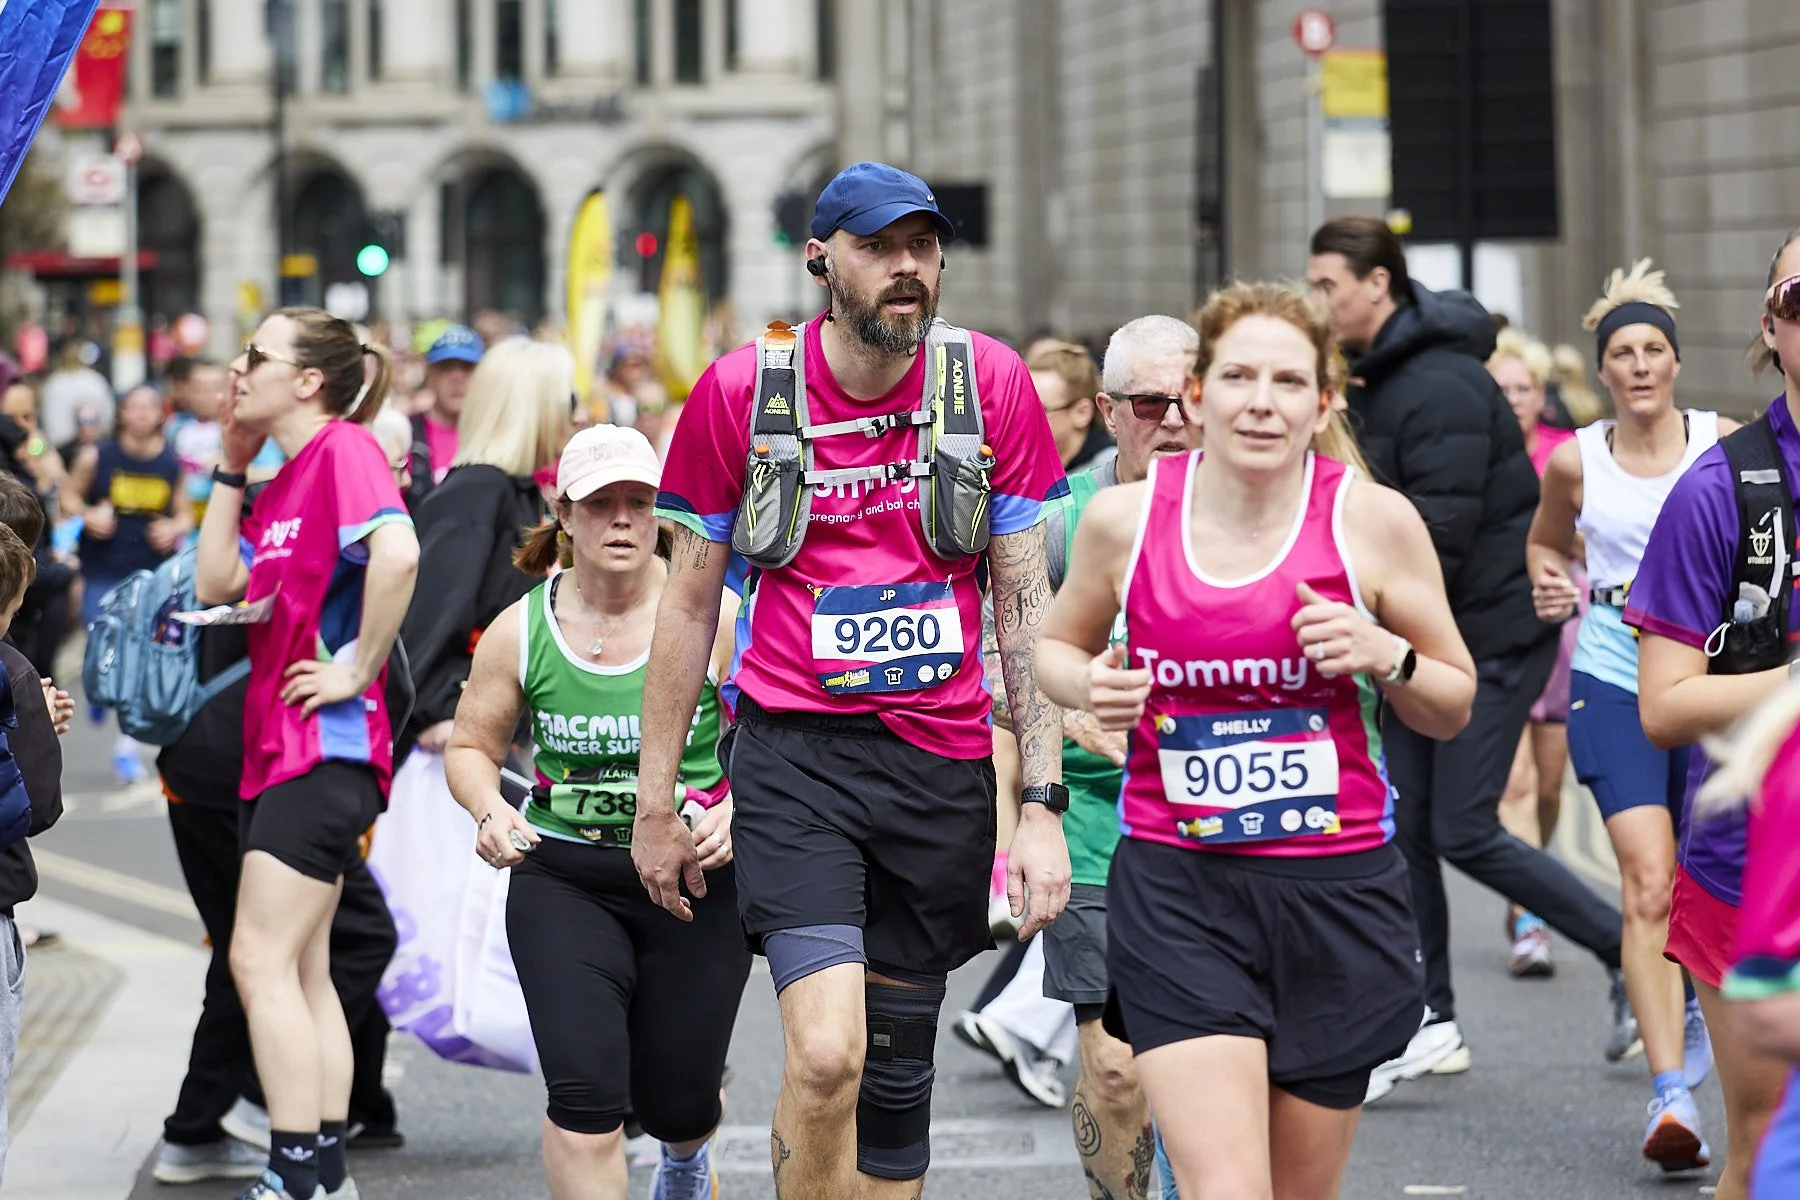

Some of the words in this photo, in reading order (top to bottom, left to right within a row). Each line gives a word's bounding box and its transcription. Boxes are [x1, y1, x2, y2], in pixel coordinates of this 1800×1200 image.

[952, 357, 965, 415] AONIJIE
[865, 499, 885, 516] and
[879, 588, 897, 601] JP
[834, 613, 941, 655] 9260
[1135, 646, 1336, 691] Tommy
[1211, 718, 1273, 737] SHELLY
[1184, 748, 1309, 797] 9055
